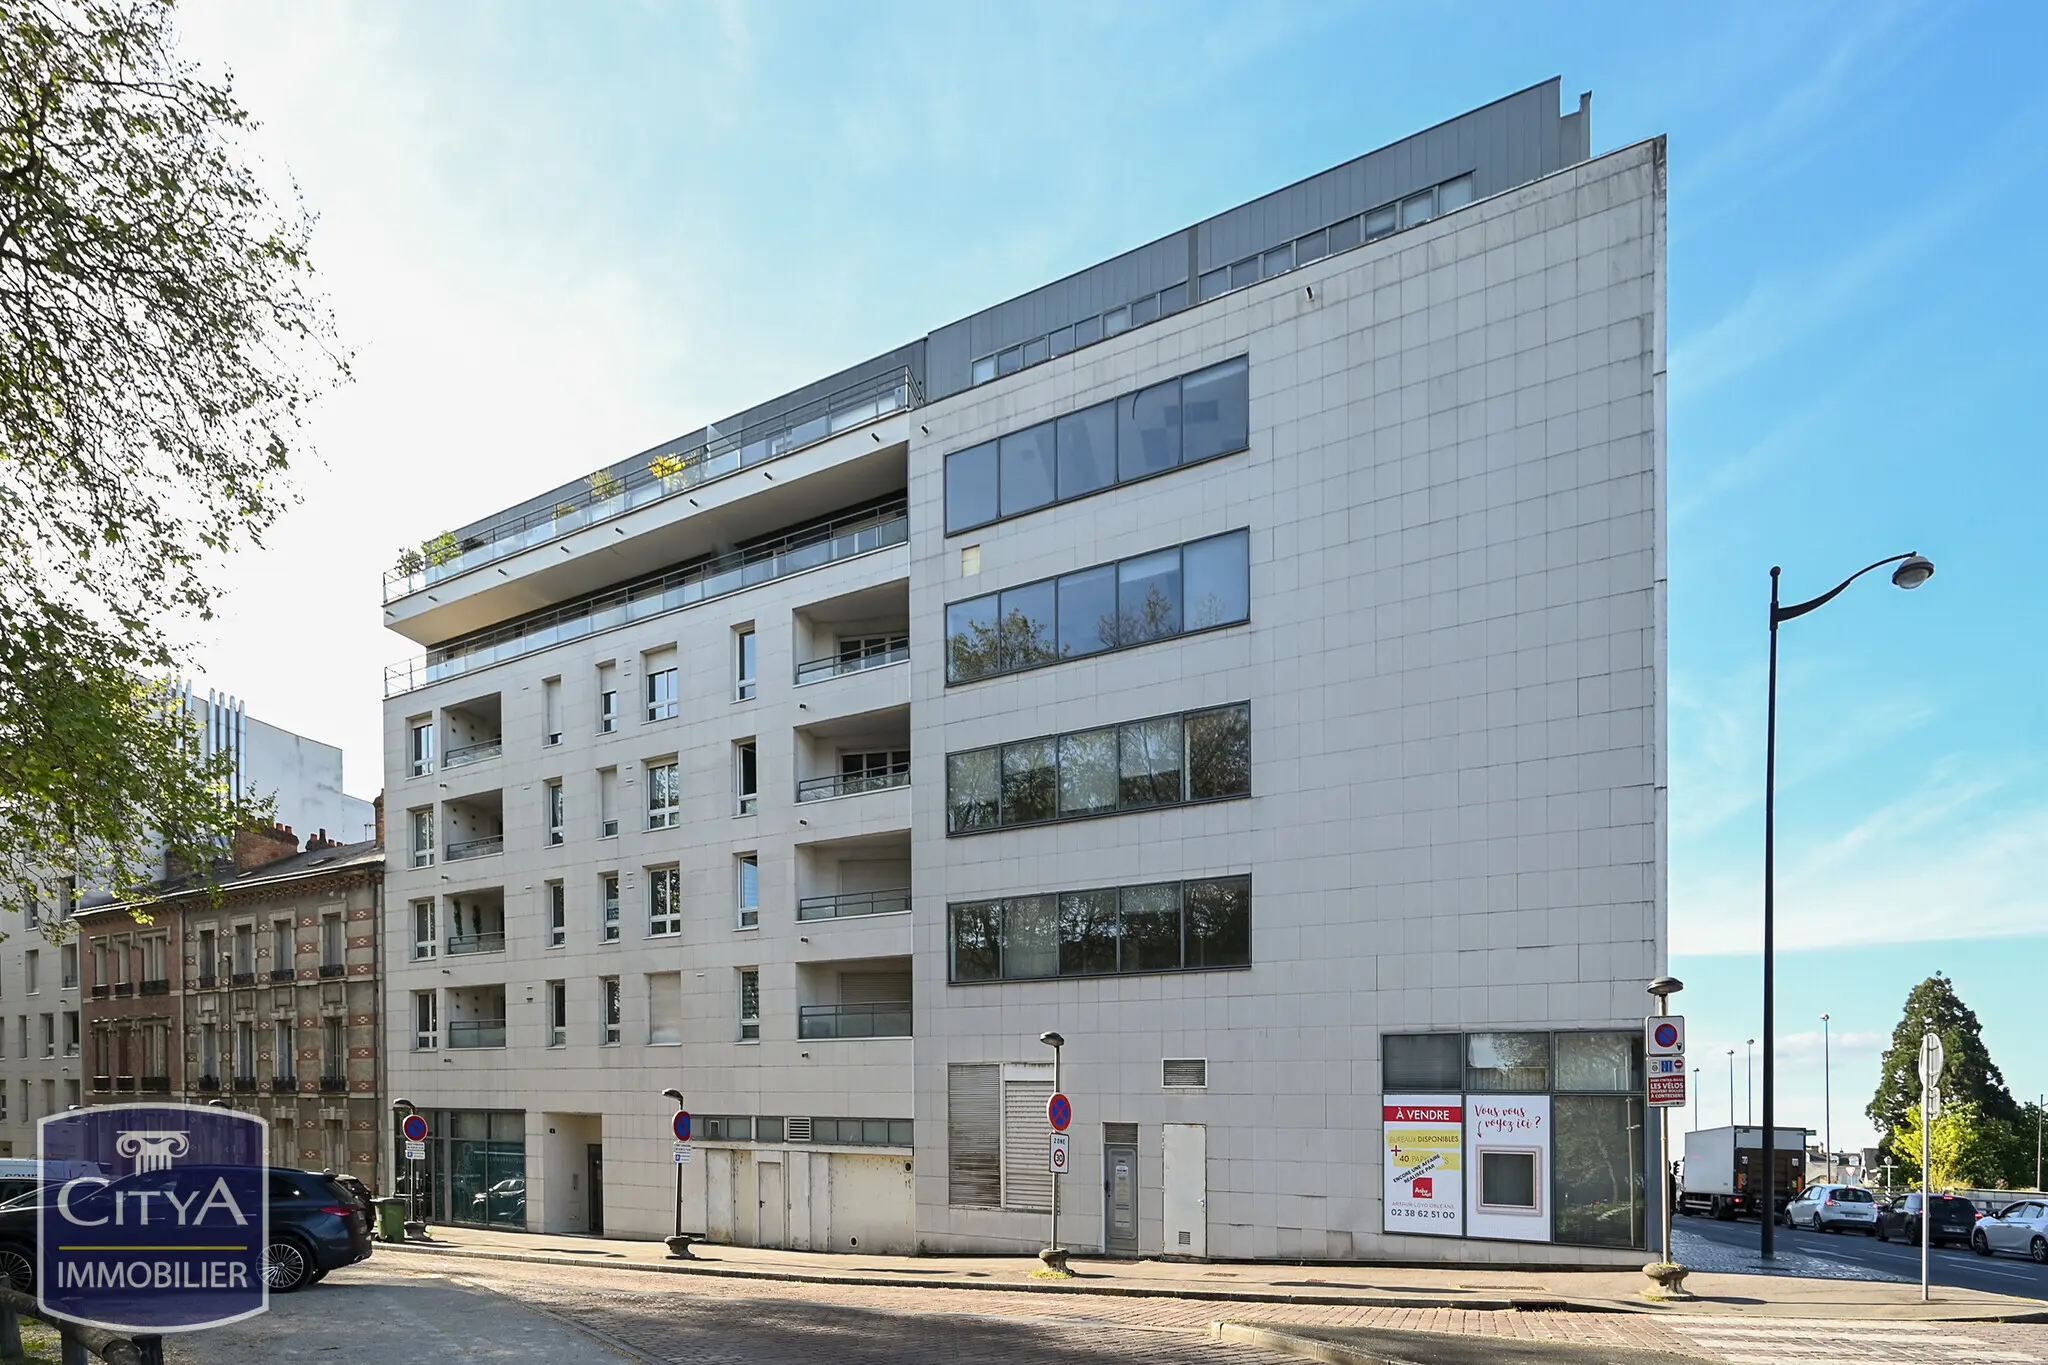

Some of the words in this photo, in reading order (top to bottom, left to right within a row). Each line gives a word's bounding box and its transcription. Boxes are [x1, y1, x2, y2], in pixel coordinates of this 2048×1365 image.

[1395, 1107, 1404, 1120] À
[1407, 1110, 1450, 1120] VENDRE
[1475, 1104, 1499, 1117] Vous
[1502, 1107, 1526, 1117] vous
[1485, 1118, 1514, 1132] voyez
[1517, 1119, 1532, 1129] ici
[1053, 1137, 1066, 1145] ZONE
[1417, 1135, 1459, 1143] DISPONIBLES
[1392, 1170, 1412, 1183] ENCORE
[1411, 1164, 1421, 1173] UNE
[1422, 1153, 1441, 1167] AFFAIRE
[1425, 1163, 1436, 1172] PAR
[1391, 1208, 1402, 1216] 02
[1405, 1209, 1415, 1217] 38
[1417, 1210, 1428, 1218] 62
[1431, 1210, 1440, 1218] 51
[1442, 1211, 1455, 1219] 00
